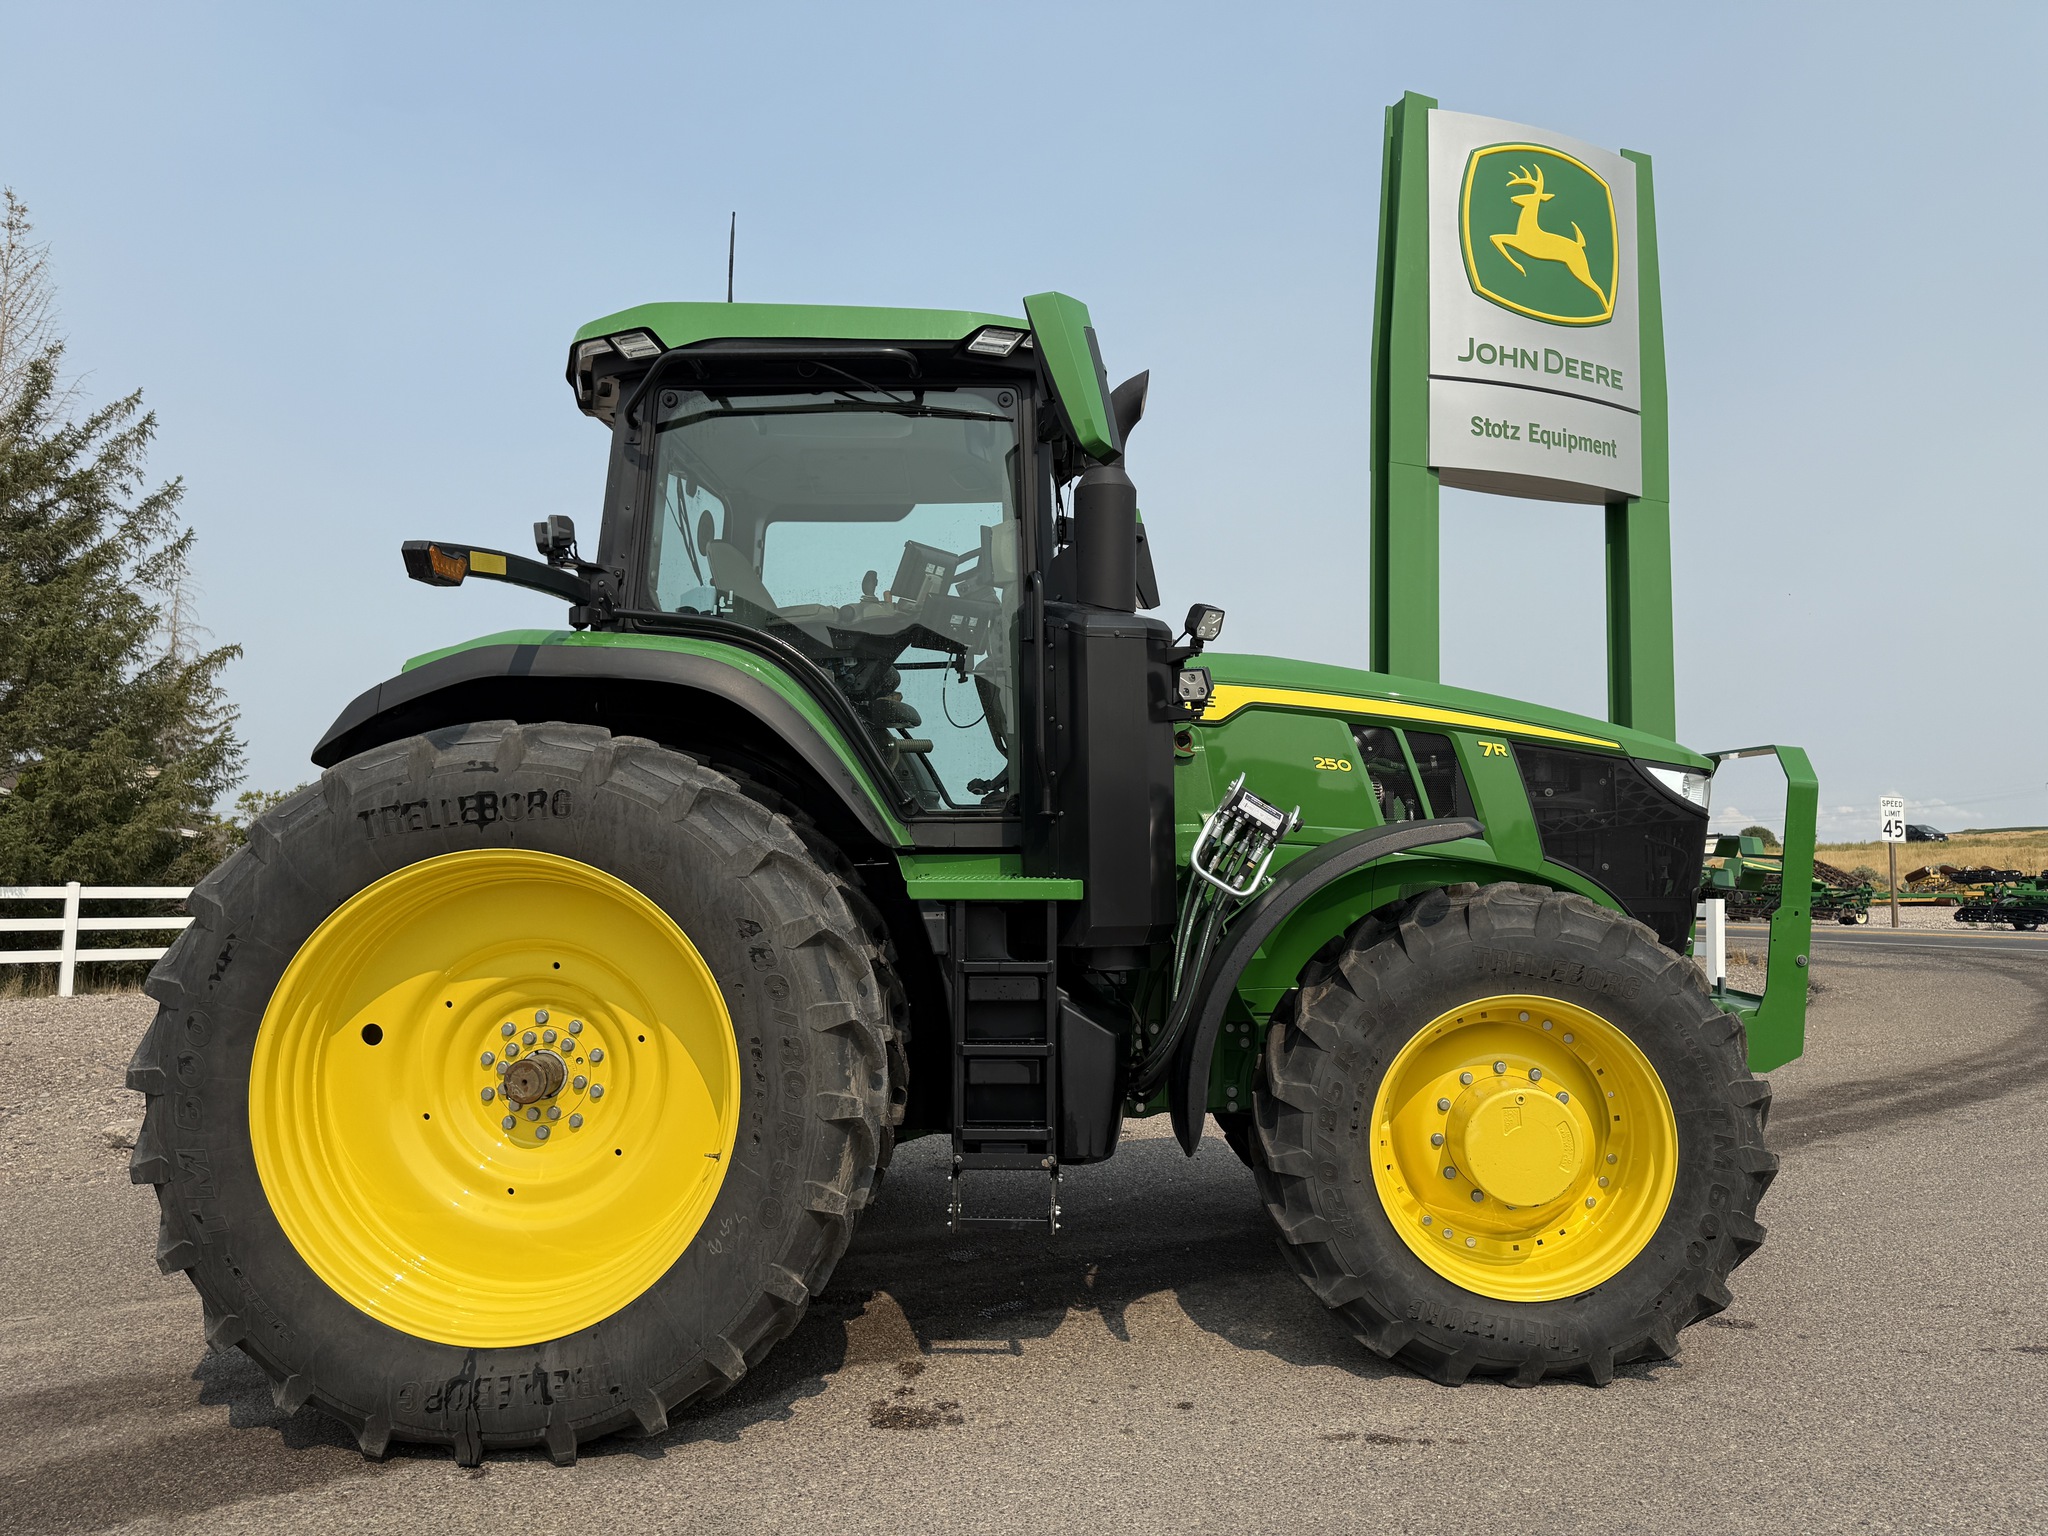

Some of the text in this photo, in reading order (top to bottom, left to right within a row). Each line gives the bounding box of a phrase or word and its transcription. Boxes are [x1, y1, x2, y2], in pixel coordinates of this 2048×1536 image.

[1457, 337, 1623, 391] JOHN DEERE
[1470, 415, 1617, 459] Stotz Equipment
[1477, 741, 1509, 758] 7R
[1313, 756, 1352, 772] 250
[1881, 799, 1903, 808] SPEED
[357, 787, 575, 841] TRELLEBORG
[1883, 819, 1904, 838] 45
